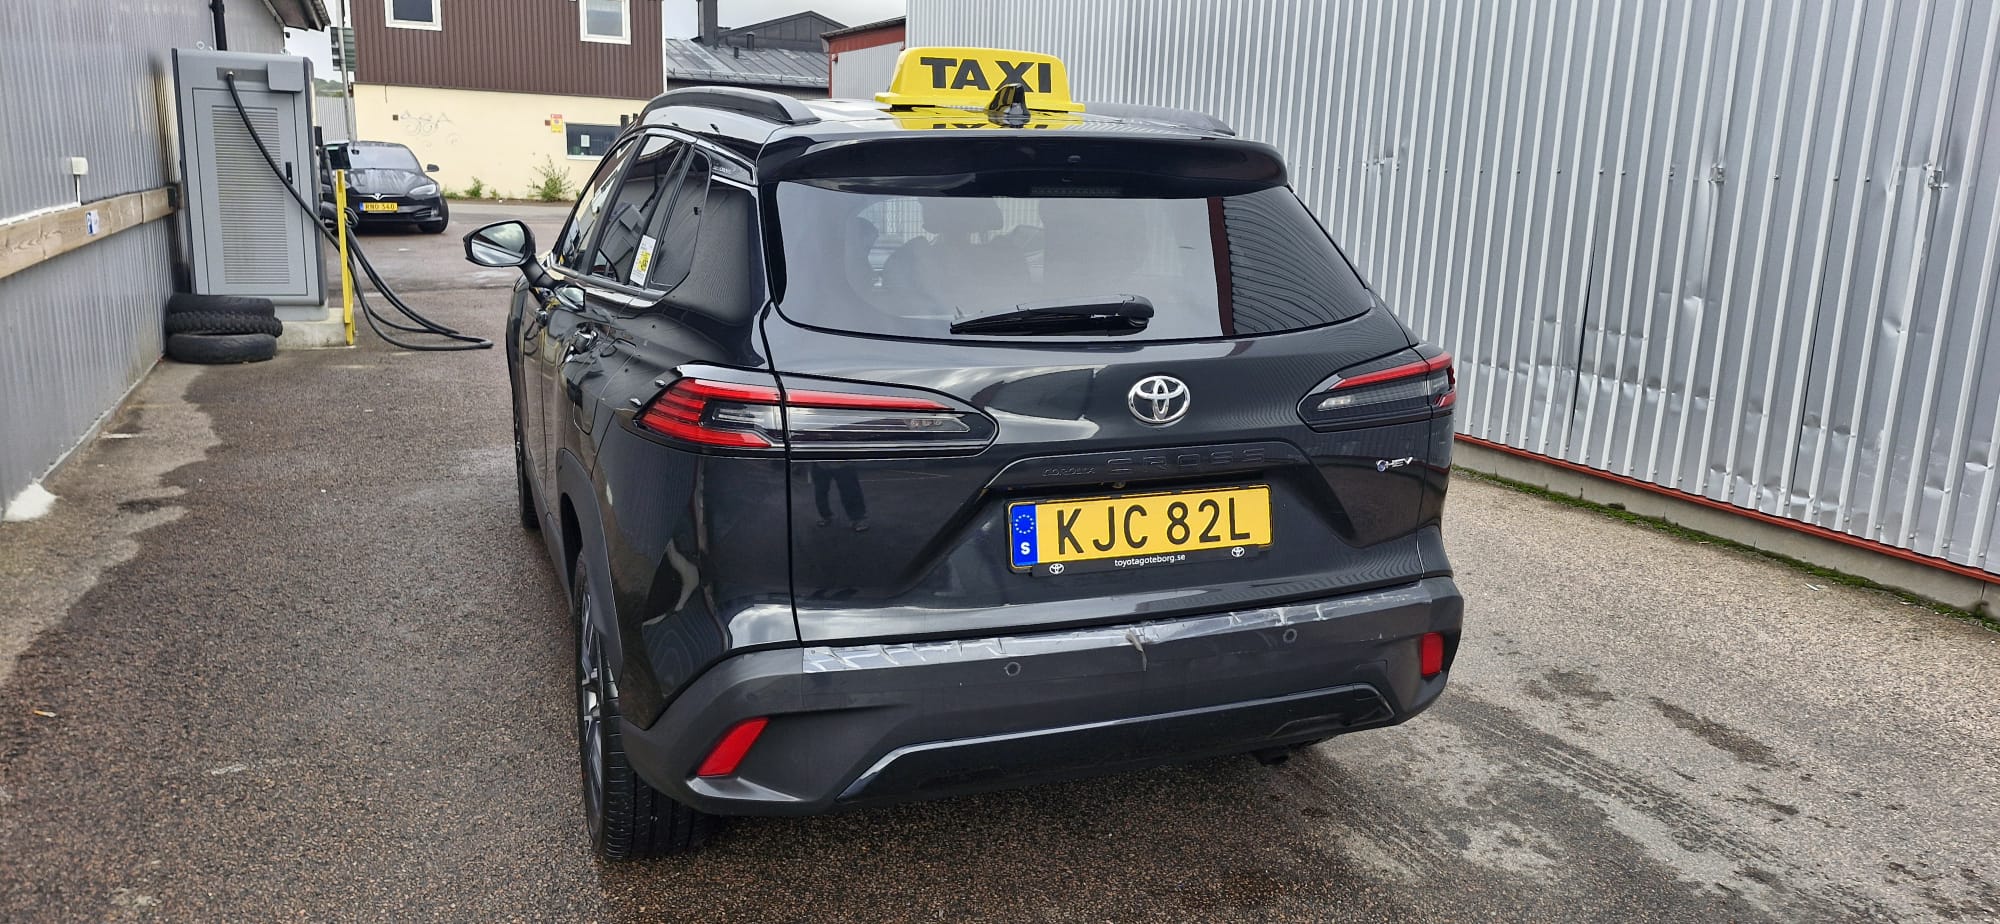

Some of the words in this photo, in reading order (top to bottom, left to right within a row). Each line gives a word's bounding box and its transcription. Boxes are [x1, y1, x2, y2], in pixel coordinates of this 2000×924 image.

[920, 56, 1051, 94] TAXI
[1106, 449, 1265, 474] CROSS
[1056, 504, 1149, 555] KJC
[1166, 497, 1251, 545] 82L
[1020, 541, 1031, 555] S
[1114, 554, 1186, 567] toyotagoteborg.se
